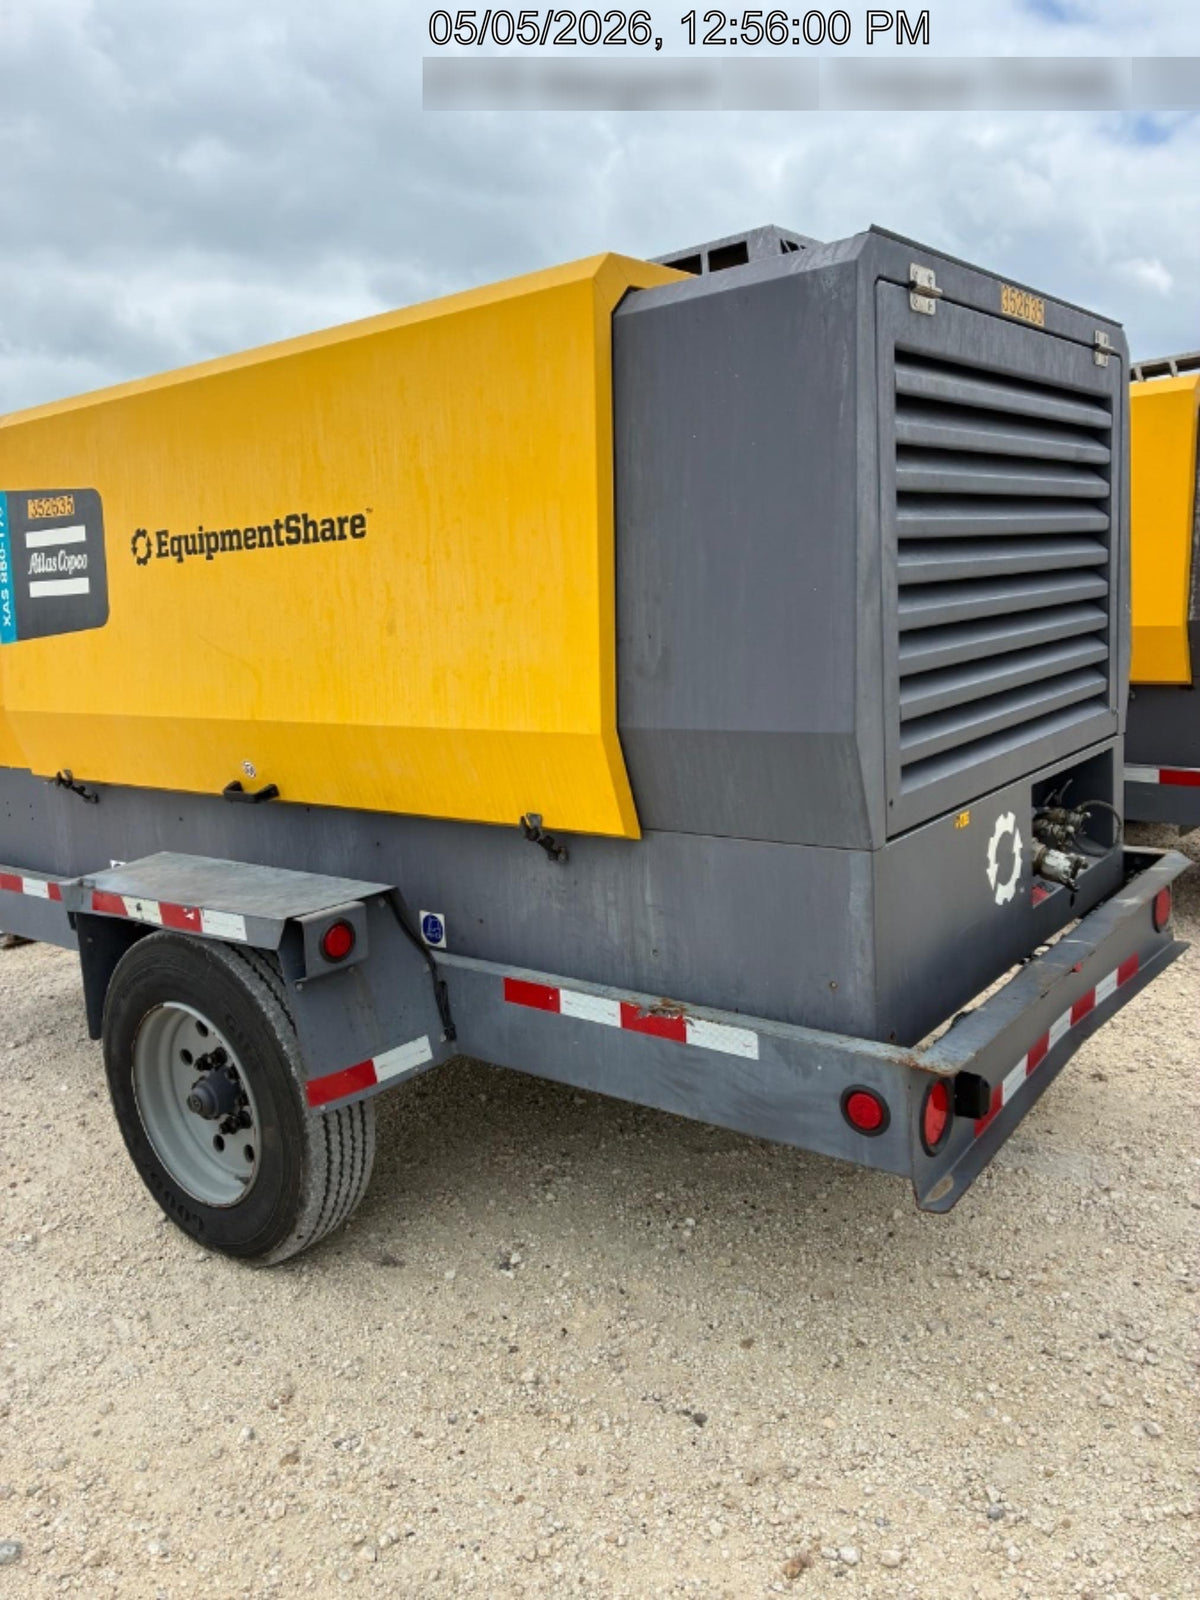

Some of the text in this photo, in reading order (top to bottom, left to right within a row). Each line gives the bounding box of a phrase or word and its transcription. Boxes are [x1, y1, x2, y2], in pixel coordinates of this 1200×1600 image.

[156, 512, 367, 563] EquipmentShare
[28, 549, 88, 575] Atlas Copco
[1, 588, 11, 627] XAS
